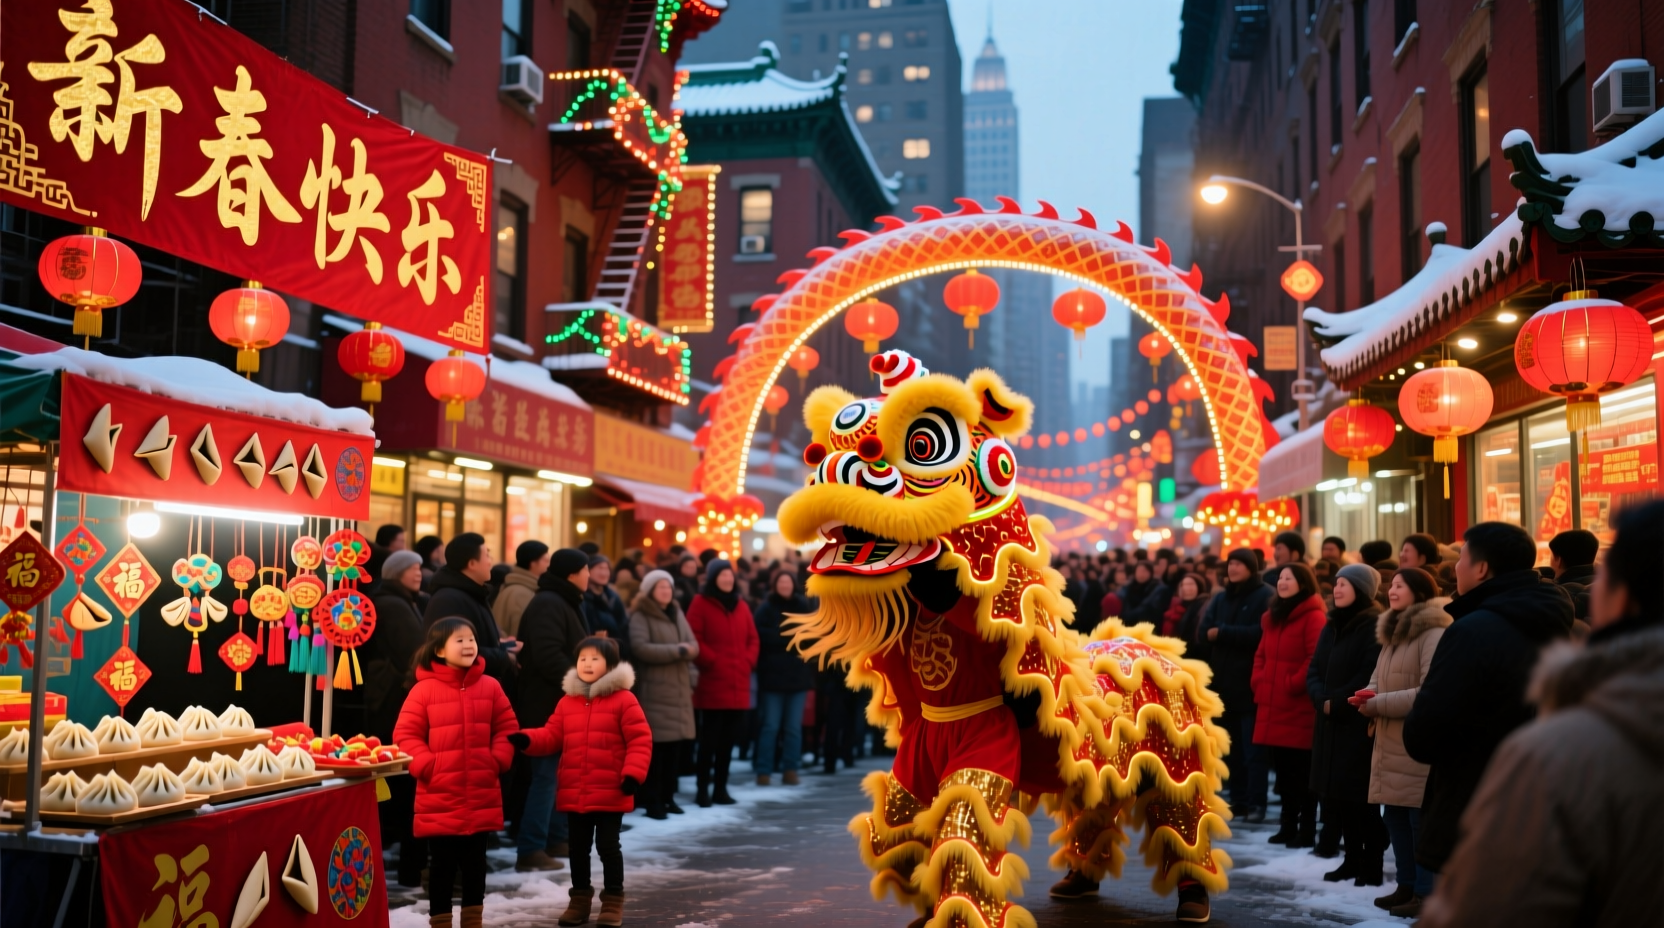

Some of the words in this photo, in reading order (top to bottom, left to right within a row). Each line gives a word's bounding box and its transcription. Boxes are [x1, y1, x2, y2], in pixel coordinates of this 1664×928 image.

[27, 0, 462, 306] 新春快乐
[5, 552, 40, 588] 福
[112, 561, 146, 600] 福
[109, 659, 138, 692] 福
